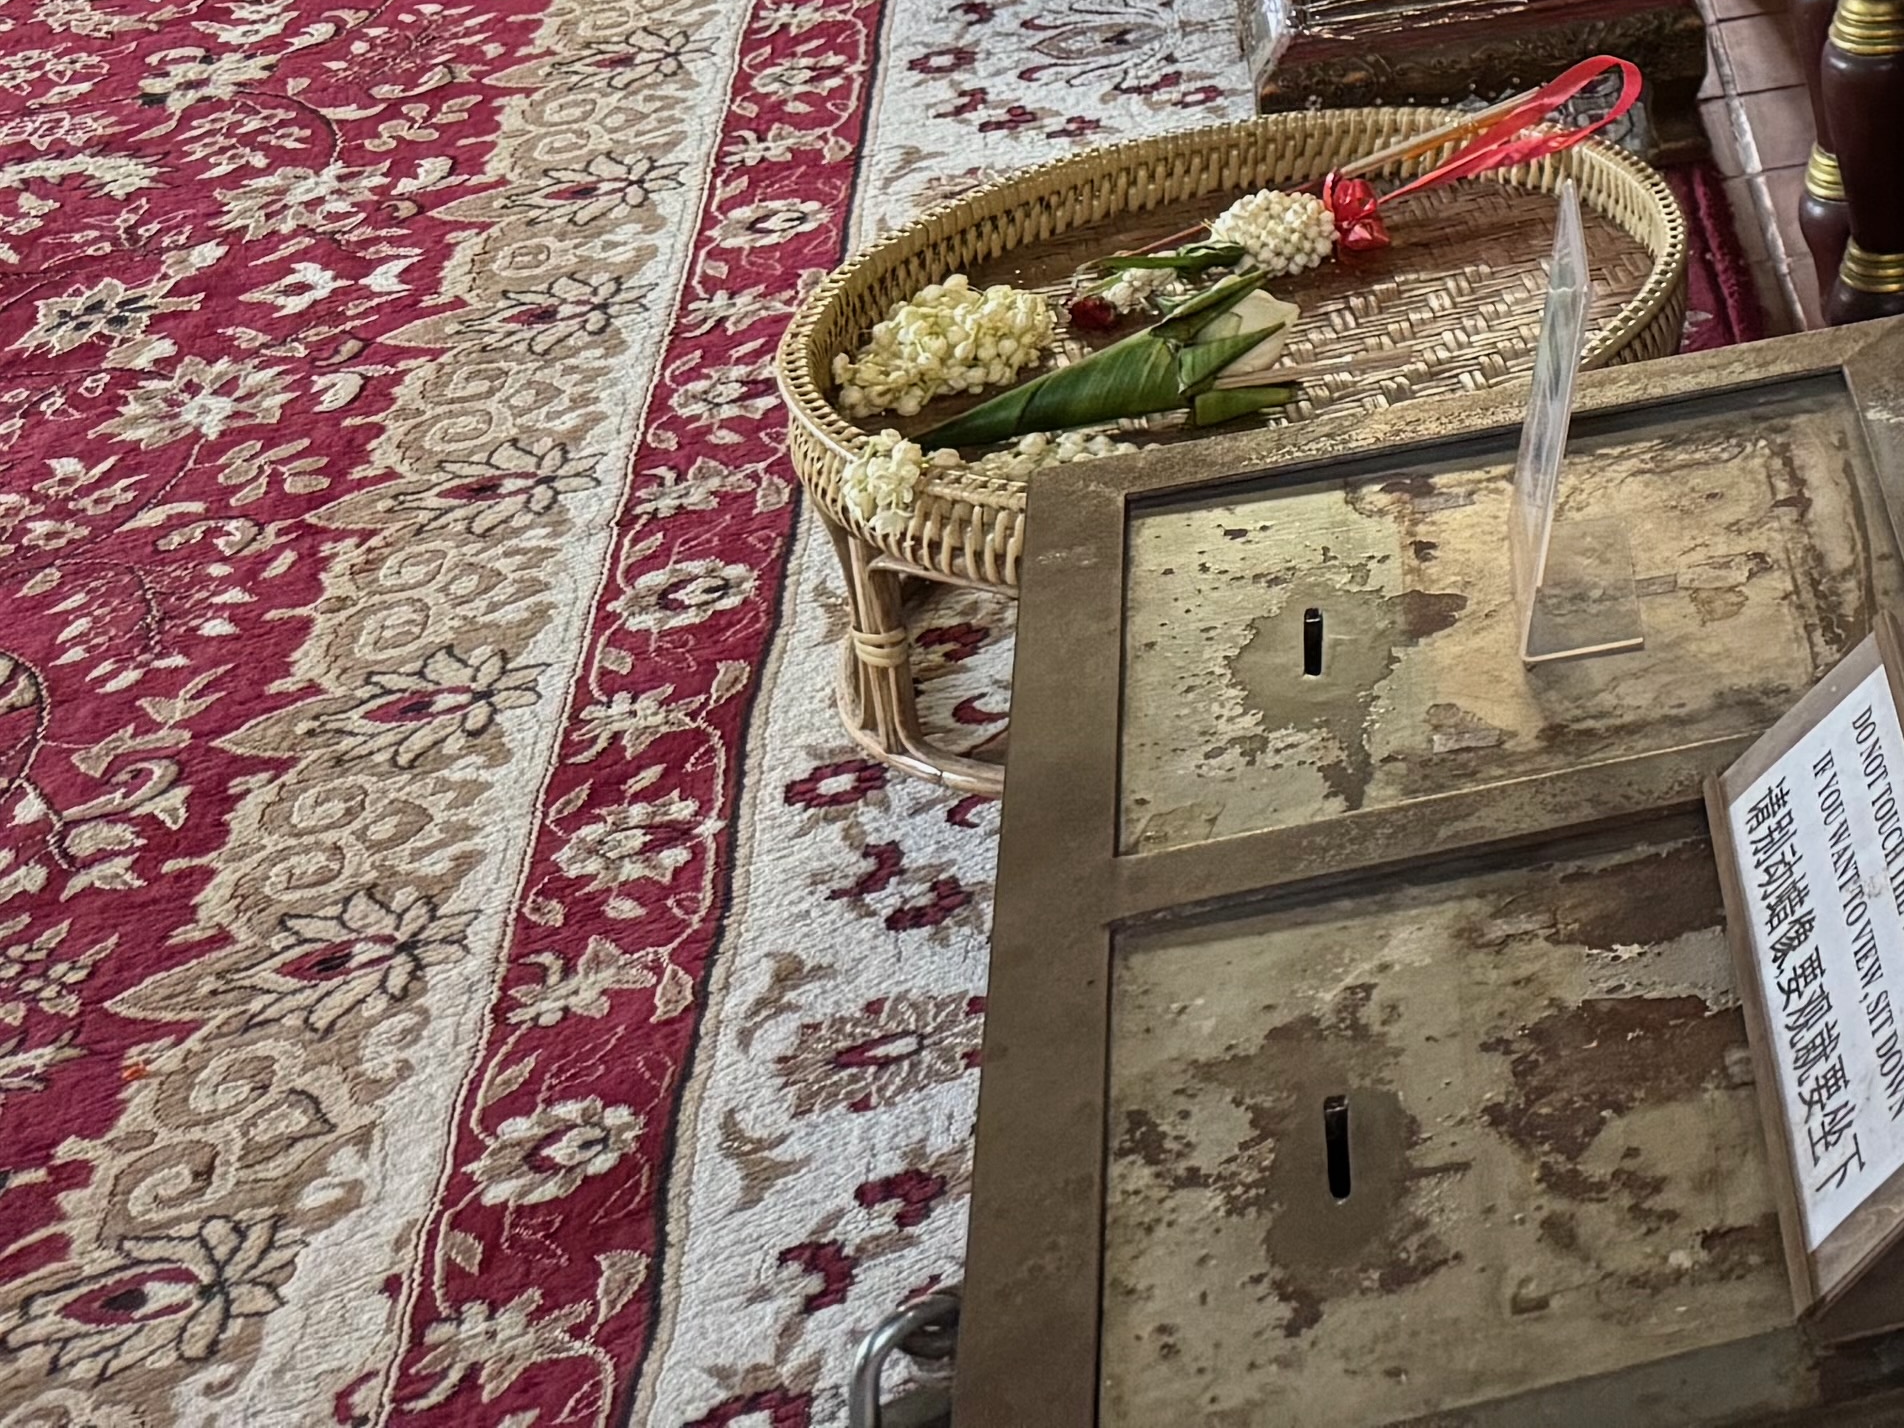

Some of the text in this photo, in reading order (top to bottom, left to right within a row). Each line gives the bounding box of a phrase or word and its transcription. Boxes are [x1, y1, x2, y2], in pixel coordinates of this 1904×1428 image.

[1852, 705, 1876, 744] DO
[1813, 749, 1834, 779] IF
[1860, 737, 1888, 790] NOT
[1818, 771, 1845, 826] YOU
[1829, 817, 1860, 893] WANT
[1843, 884, 1867, 926] TO
[1852, 918, 1883, 1003] VIEW,
[1866, 990, 1894, 1038] SIT
